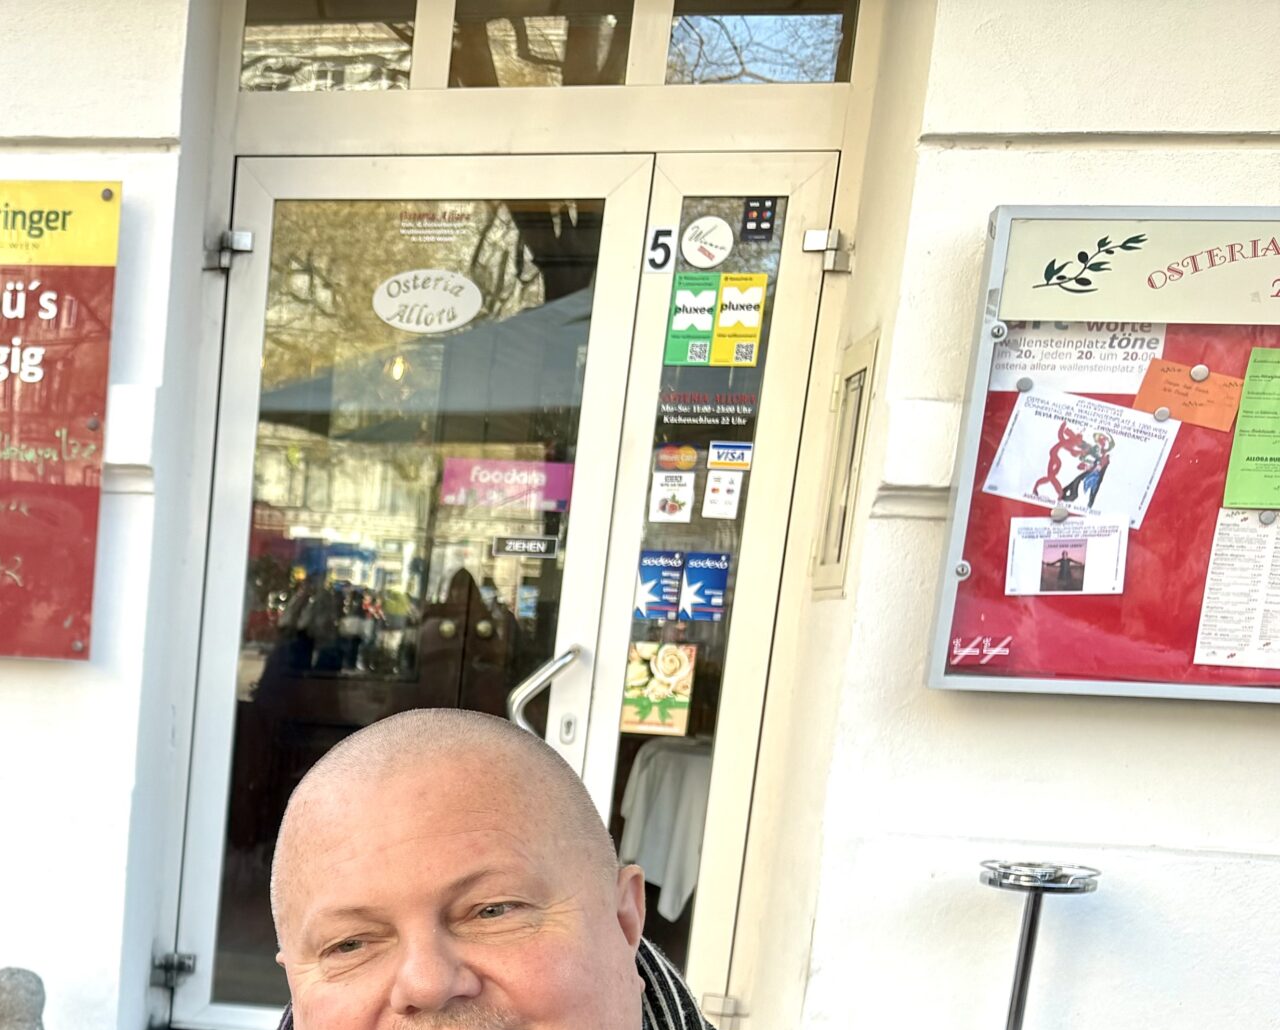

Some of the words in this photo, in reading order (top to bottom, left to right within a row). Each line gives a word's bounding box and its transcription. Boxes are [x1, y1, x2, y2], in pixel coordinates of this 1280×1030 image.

[648, 229, 673, 270] 5
[1147, 236, 1280, 290] OSTERIA
[386, 273, 465, 298] Osteria
[673, 304, 715, 316] pluxee
[720, 301, 761, 313] pluxee
[387, 303, 458, 326] Allora
[999, 336, 1107, 351] wallensteinplatz
[1108, 333, 1160, 350] töne
[996, 350, 1012, 360] im
[1016, 350, 1036, 360] 20.
[1040, 350, 1072, 362] jeden
[1099, 352, 1118, 361] um
[995, 361, 1027, 371] osteria
[1030, 361, 1056, 372] allora
[1059, 362, 1135, 374] wallensteinplatz
[736, 404, 753, 414] Uhr
[731, 416, 748, 426] Uhr
[716, 450, 746, 462] VISA
[505, 540, 547, 553] ZIEHEN
[642, 555, 684, 567] sodexo
[687, 557, 728, 569] sodexo
